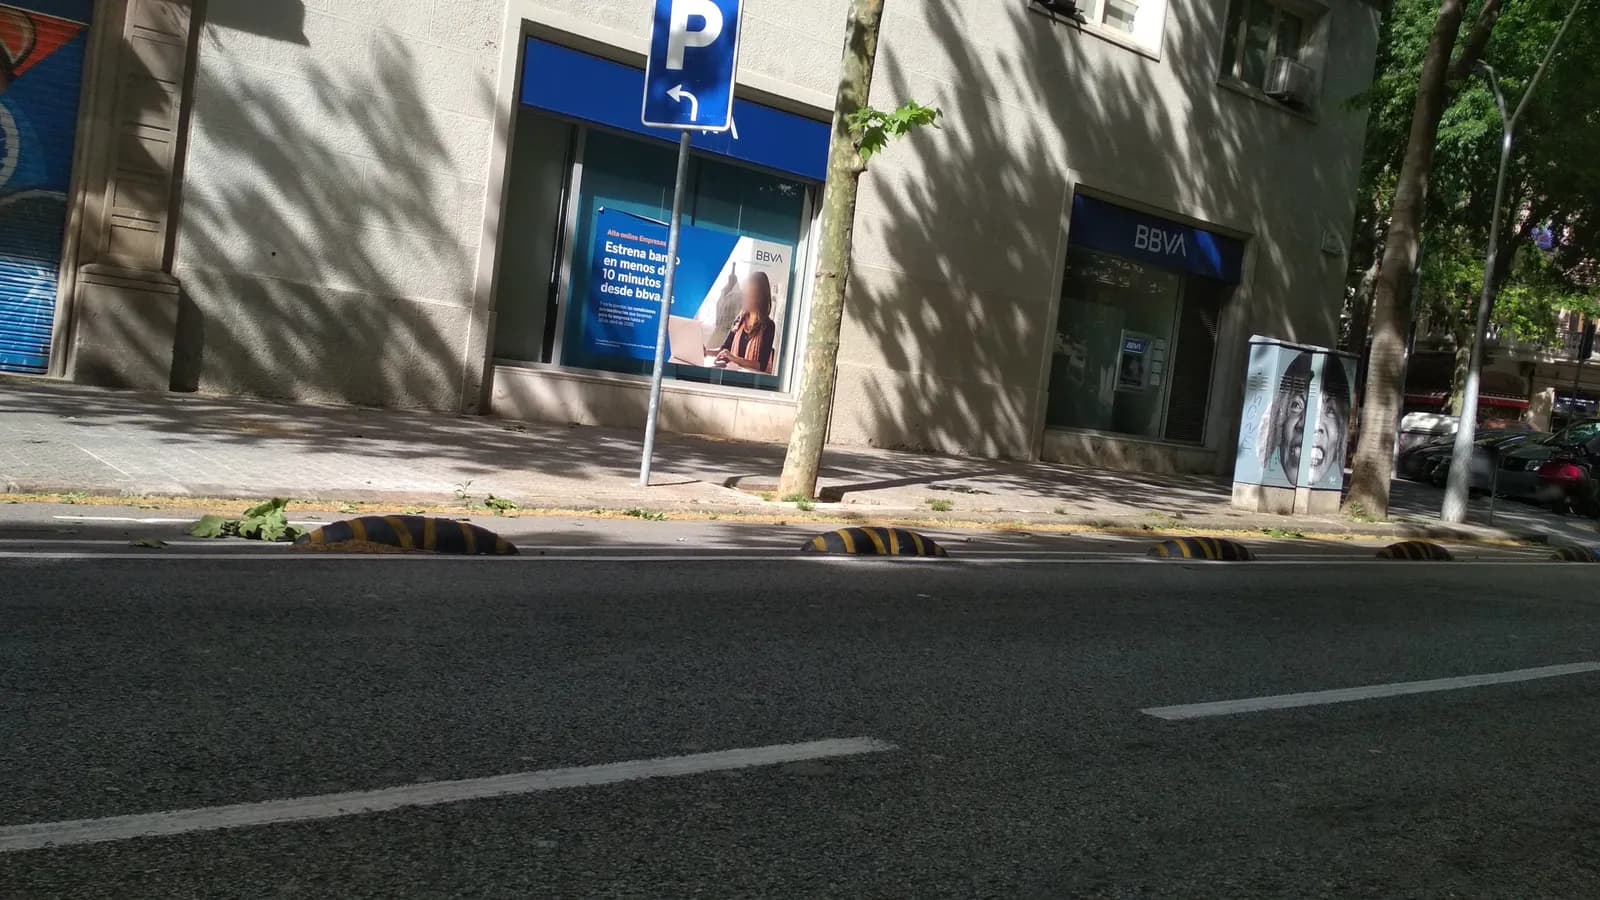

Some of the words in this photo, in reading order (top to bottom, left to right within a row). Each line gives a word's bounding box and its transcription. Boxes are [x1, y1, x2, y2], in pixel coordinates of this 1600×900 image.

[665, 0, 724, 70] P
[1134, 224, 1187, 256] BBVA
[605, 241, 647, 260] Estrena
[648, 249, 681, 265] bano
[756, 250, 783, 264] BBVA
[603, 257, 618, 268] en
[619, 259, 656, 274] menos
[657, 265, 667, 277] d
[602, 268, 616, 280] 10
[617, 272, 662, 289] minutos
[600, 282, 634, 297] desde
